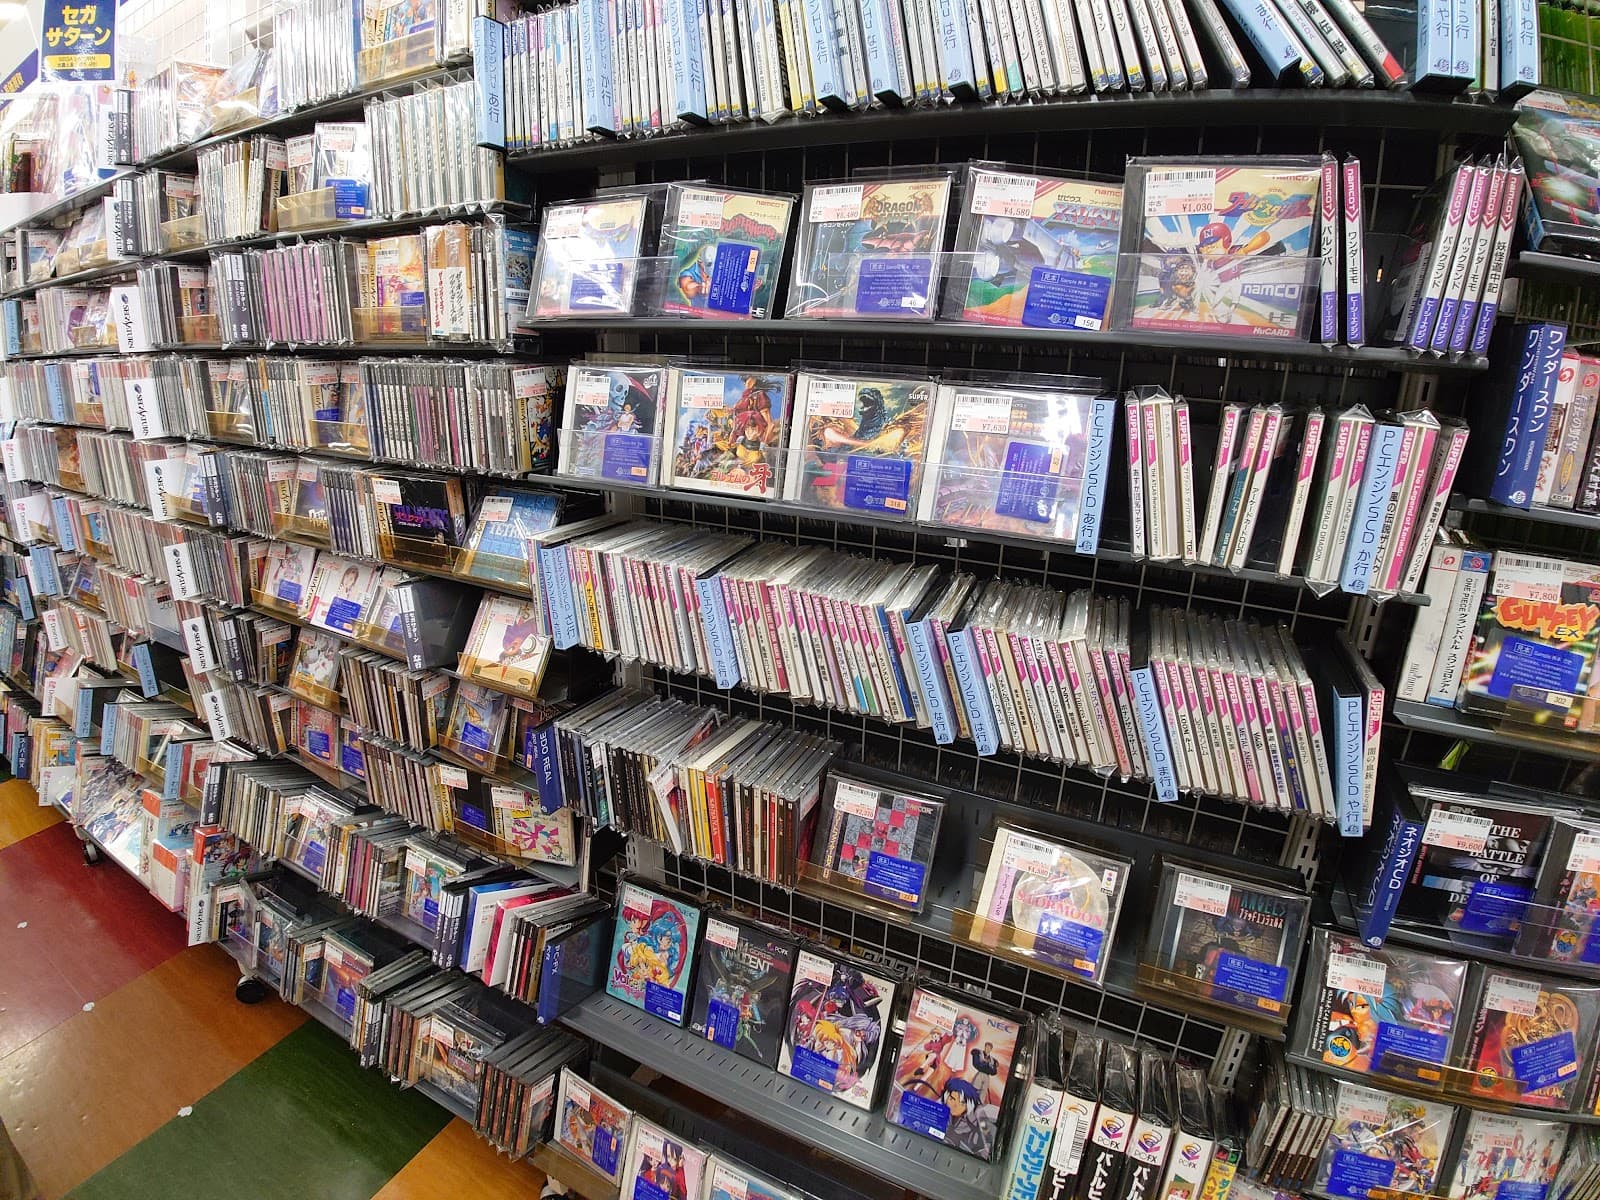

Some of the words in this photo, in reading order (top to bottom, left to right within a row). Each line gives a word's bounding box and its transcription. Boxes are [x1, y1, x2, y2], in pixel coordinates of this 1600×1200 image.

[62, 5, 97, 25] セガ
[1436, 8, 1450, 38] や行
[1455, 12, 1471, 40] ら行
[46, 27, 111, 47] サターン
[943, 23, 956, 50] は行
[1520, 17, 1534, 46] わ行
[815, 39, 829, 65] た行
[487, 91, 501, 123] あ行
[877, 201, 922, 213] DRAGON
[1003, 206, 1031, 217] ¥4,580
[1057, 193, 1081, 203] ゼビウス
[1182, 203, 1213, 213] ¥1,030
[1322, 225, 1333, 267] バルンバ
[1347, 231, 1359, 284] ワンダーモモ
[1431, 235, 1454, 289] パックランド
[1451, 235, 1472, 290] パックランド
[1467, 238, 1488, 292] ワンダーモモ
[1487, 241, 1506, 294] 妖怪道中記
[1243, 283, 1300, 300] namco
[1082, 319, 1094, 328] 156
[1252, 326, 1290, 337] HuCARD
[1528, 330, 1563, 433] ワンダースワン
[1498, 329, 1539, 477] ワンダースワン
[1129, 408, 1138, 440] SUPER
[1146, 410, 1154, 441] SUPER
[1179, 416, 1187, 446] SUPER
[1221, 417, 1234, 449] SUPER
[1247, 418, 1259, 449] SUPER
[1263, 420, 1277, 452] SUPER
[1087, 403, 1105, 508] PCエンジンSCD
[1305, 425, 1319, 459] SUPER
[1335, 426, 1349, 459] SUPER
[1357, 429, 1370, 462] SUPER
[1400, 430, 1414, 465] SUPER
[1446, 437, 1463, 472] SUPER
[711, 470, 750, 486] アルナムの
[744, 462, 772, 494] 牙
[1361, 430, 1396, 544] PCエンジンSCD
[1416, 468, 1424, 484] The
[1410, 485, 1422, 516] Legend
[1080, 513, 1094, 538] あ行
[1314, 532, 1326, 562] DRAGON
[1396, 525, 1410, 557] Xanadu
[1353, 549, 1371, 575] か行
[1465, 577, 1473, 593] ONE
[1496, 583, 1511, 591] 中古
[1529, 592, 1558, 602] ¥7,800
[1458, 593, 1469, 613] PIECE
[1500, 598, 1596, 631] GUNPEY
[700, 581, 721, 657] PCエンジンSCD
[1555, 625, 1580, 638] EX
[1010, 634, 1022, 666] SUPER
[1049, 643, 1062, 673] SUPER
[1064, 646, 1077, 678] SUPER
[1516, 643, 1533, 655] 見本
[911, 625, 940, 708] PCエンジンSCD
[934, 712, 946, 732] な行
[1094, 652, 1105, 680] SUPER
[1109, 653, 1120, 681] SUPER
[1155, 662, 1167, 691] SUPER
[1169, 665, 1180, 694] SUPER
[1182, 667, 1194, 694] SUPER
[951, 635, 981, 720] PCエンジンSCD
[974, 721, 987, 743] は行
[1198, 670, 1209, 698] SUPER
[1212, 673, 1224, 701] SUPER
[1226, 676, 1239, 705] SUPER
[1241, 676, 1253, 705] SUPER
[1255, 680, 1268, 710] SUPER
[1271, 684, 1283, 712] SUPER
[1287, 685, 1298, 715] SUPER
[1305, 690, 1316, 719] SUPER
[1371, 691, 1382, 727] SUPER
[1553, 696, 1567, 705] 302
[539, 731, 549, 754] 3DO
[1136, 672, 1166, 763] PCエンジンSCD
[1158, 765, 1172, 788] ま行
[1347, 700, 1360, 796] PCエンジンSCD
[543, 756, 553, 785] REAL
[1346, 800, 1361, 823] や行
[1449, 806, 1478, 815] SNK
[1491, 825, 1522, 838] THE
[1388, 826, 1417, 890] ネオジオCD
[1470, 849, 1526, 864] BATTLE
[1480, 873, 1500, 884] OF
[1448, 892, 1469, 905] DE
[986, 1018, 1012, 1034] NEC
